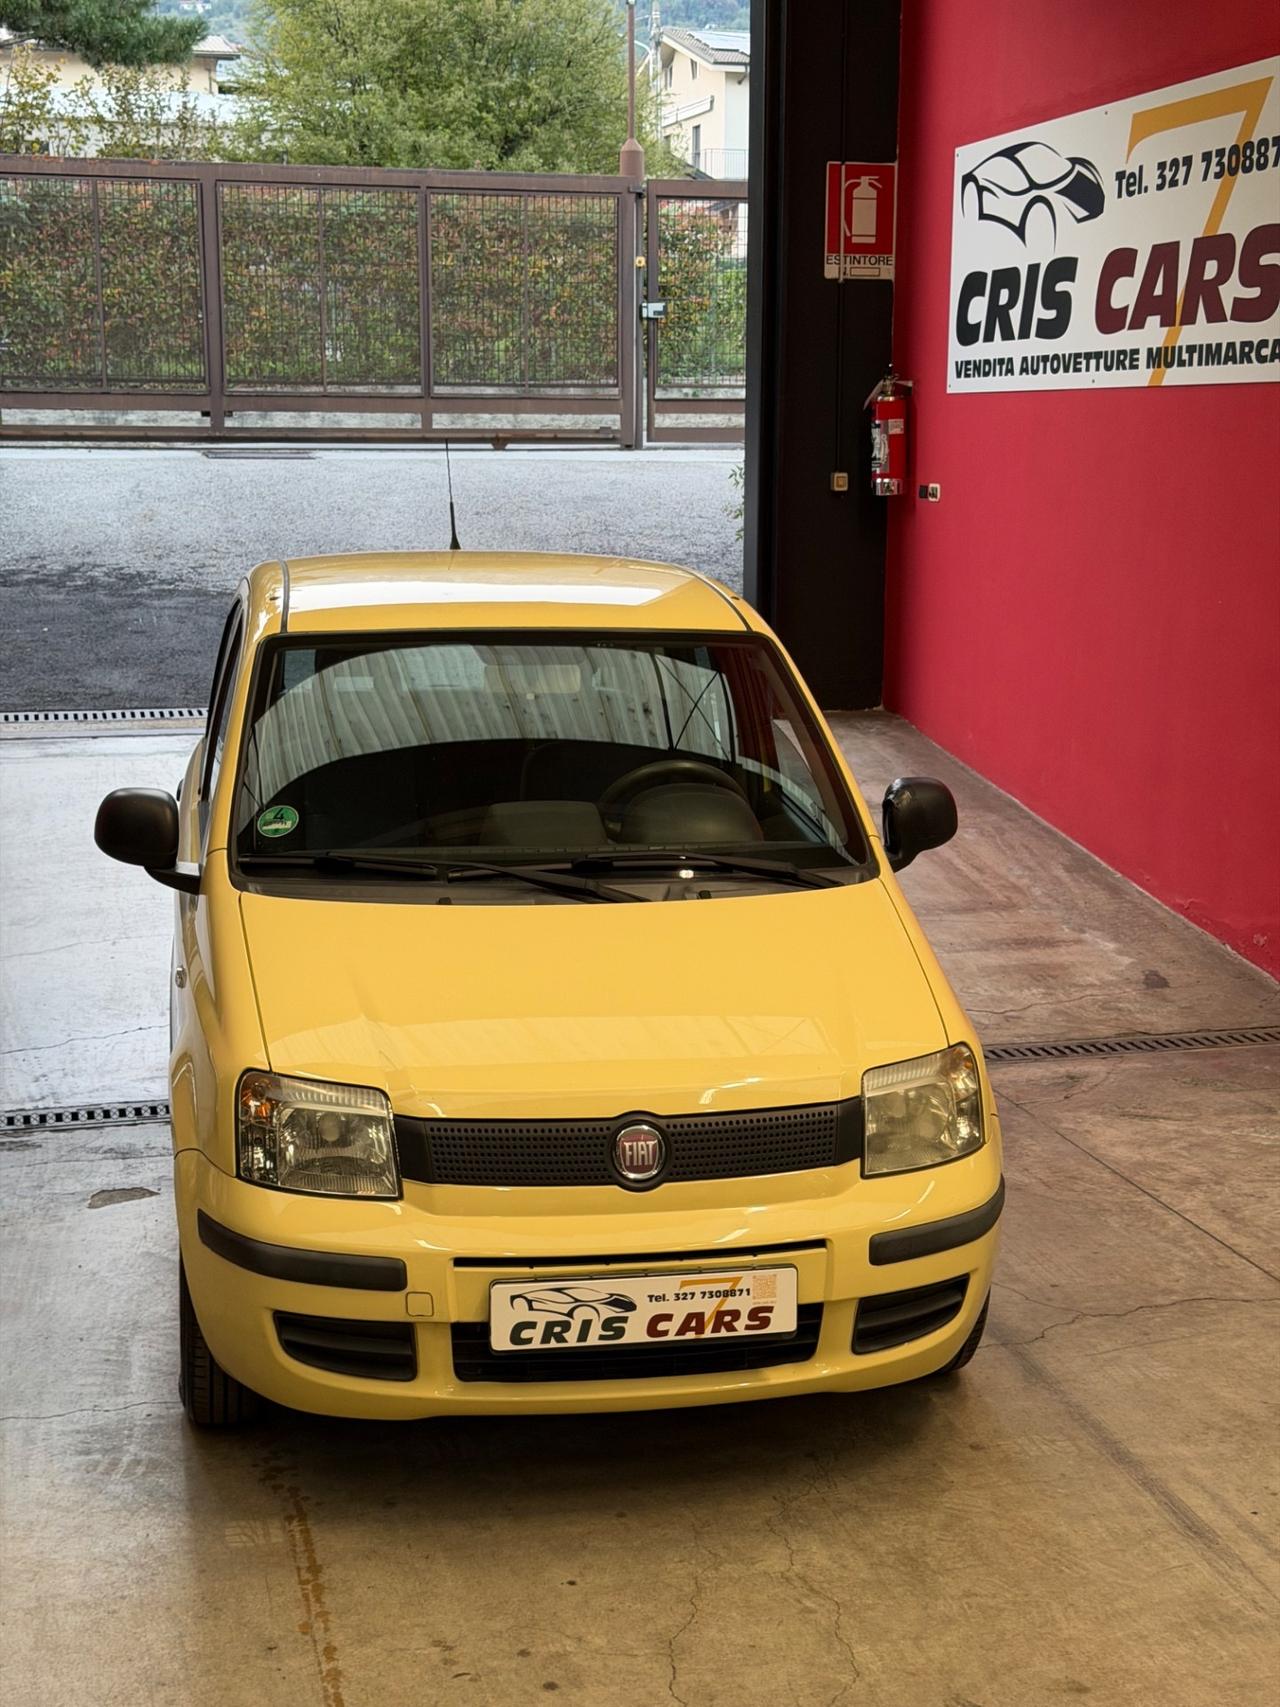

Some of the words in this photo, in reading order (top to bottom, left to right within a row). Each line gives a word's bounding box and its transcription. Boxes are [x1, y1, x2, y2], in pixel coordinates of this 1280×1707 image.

[1115, 165, 1149, 199] Tel.
[1156, 155, 1193, 192] 327
[826, 255, 893, 265] ESTINTORE
[955, 256, 1079, 347] CRIS
[1095, 223, 1280, 335] CARS
[955, 357, 1014, 378] VENDITA
[1019, 348, 1140, 376] AUTOVETTURE
[1146, 338, 1280, 370] MULTIMARCA
[272, 807, 285, 820] 4
[623, 1139, 658, 1166] FIAT
[647, 1293, 669, 1303] Tel.
[673, 1291, 696, 1301] 327
[700, 1288, 751, 1299] 7308871
[509, 1315, 629, 1346] CRIS
[646, 1305, 774, 1338] CARS
